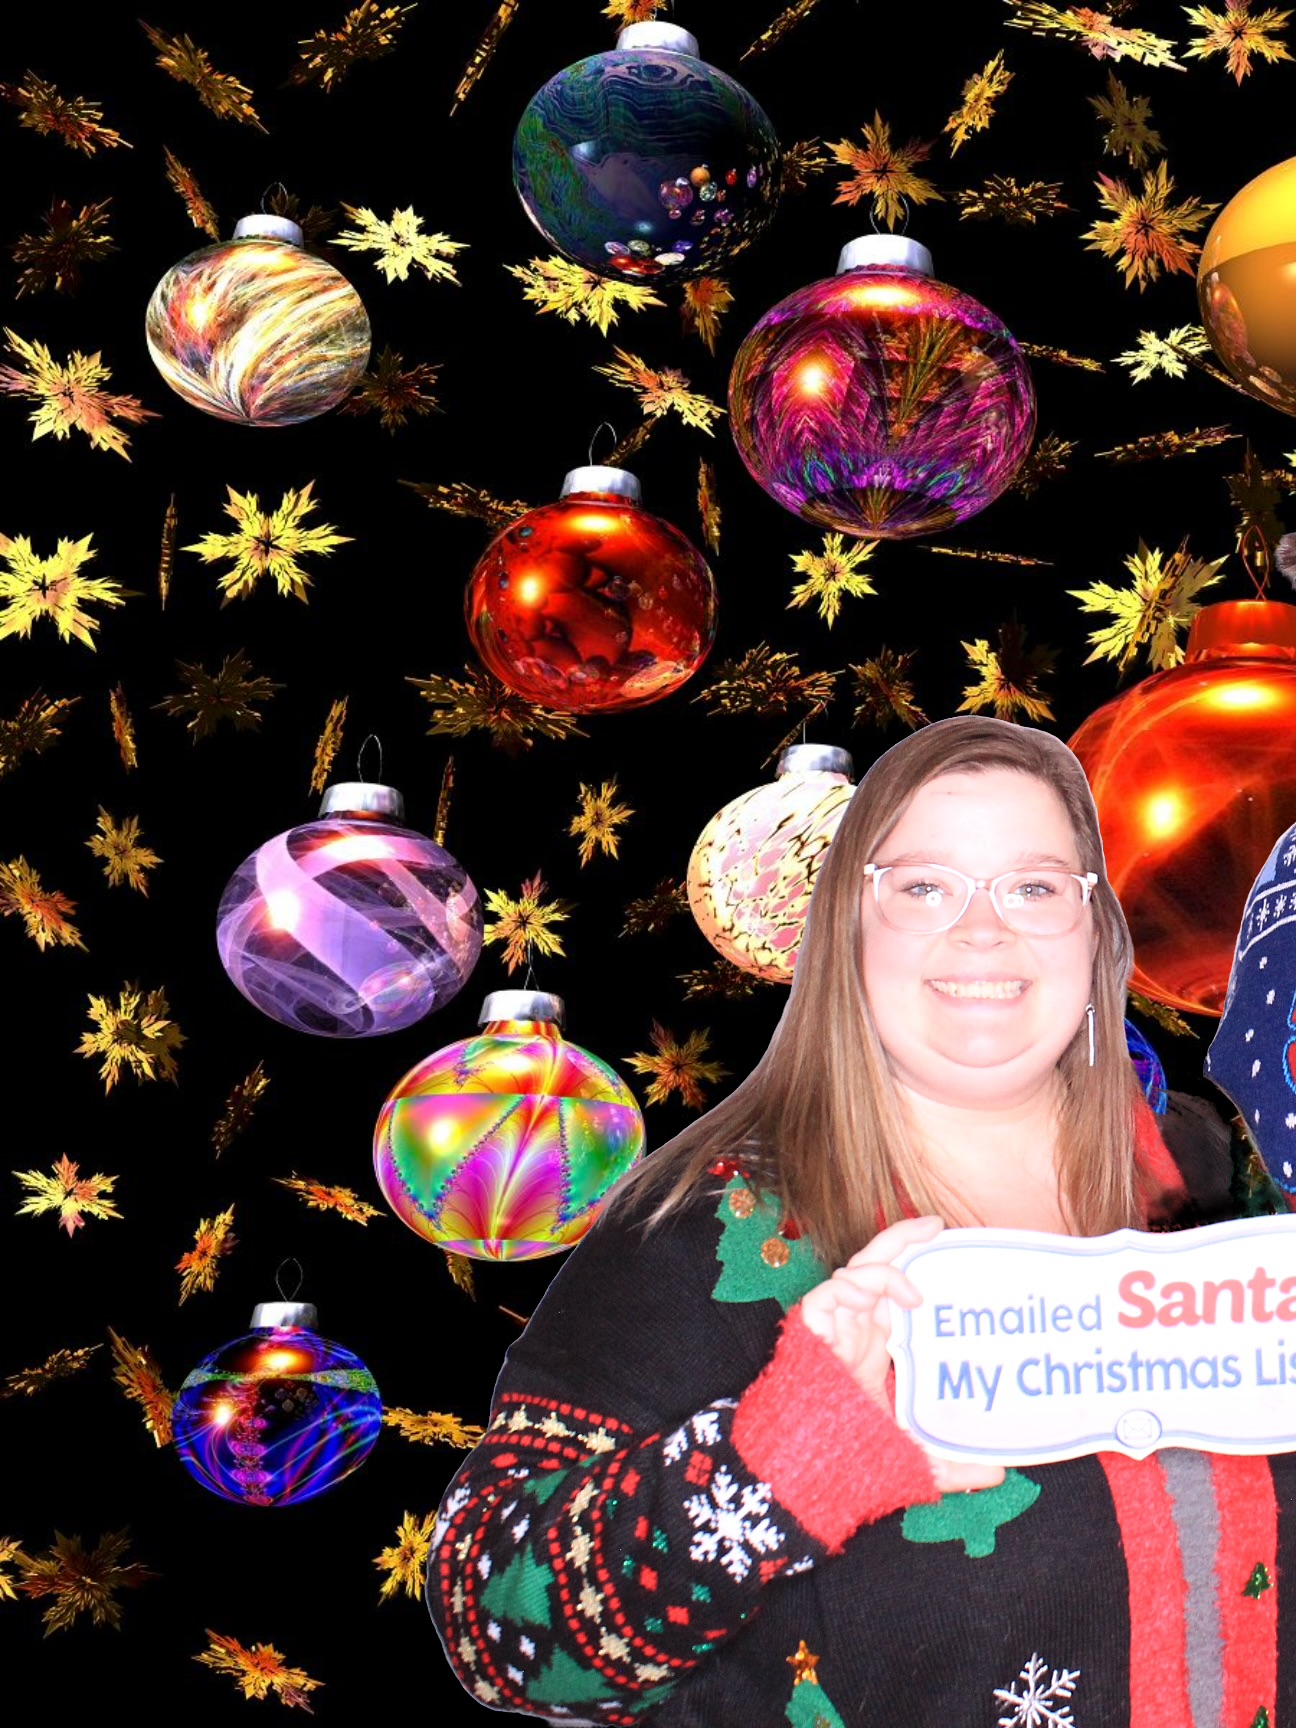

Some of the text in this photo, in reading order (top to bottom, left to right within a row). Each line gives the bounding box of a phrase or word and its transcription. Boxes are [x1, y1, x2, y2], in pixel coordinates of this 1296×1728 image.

[934, 1295, 1103, 1337] Emailed
[937, 1360, 1002, 1411] My
[1016, 1348, 1242, 1397] Christmas
